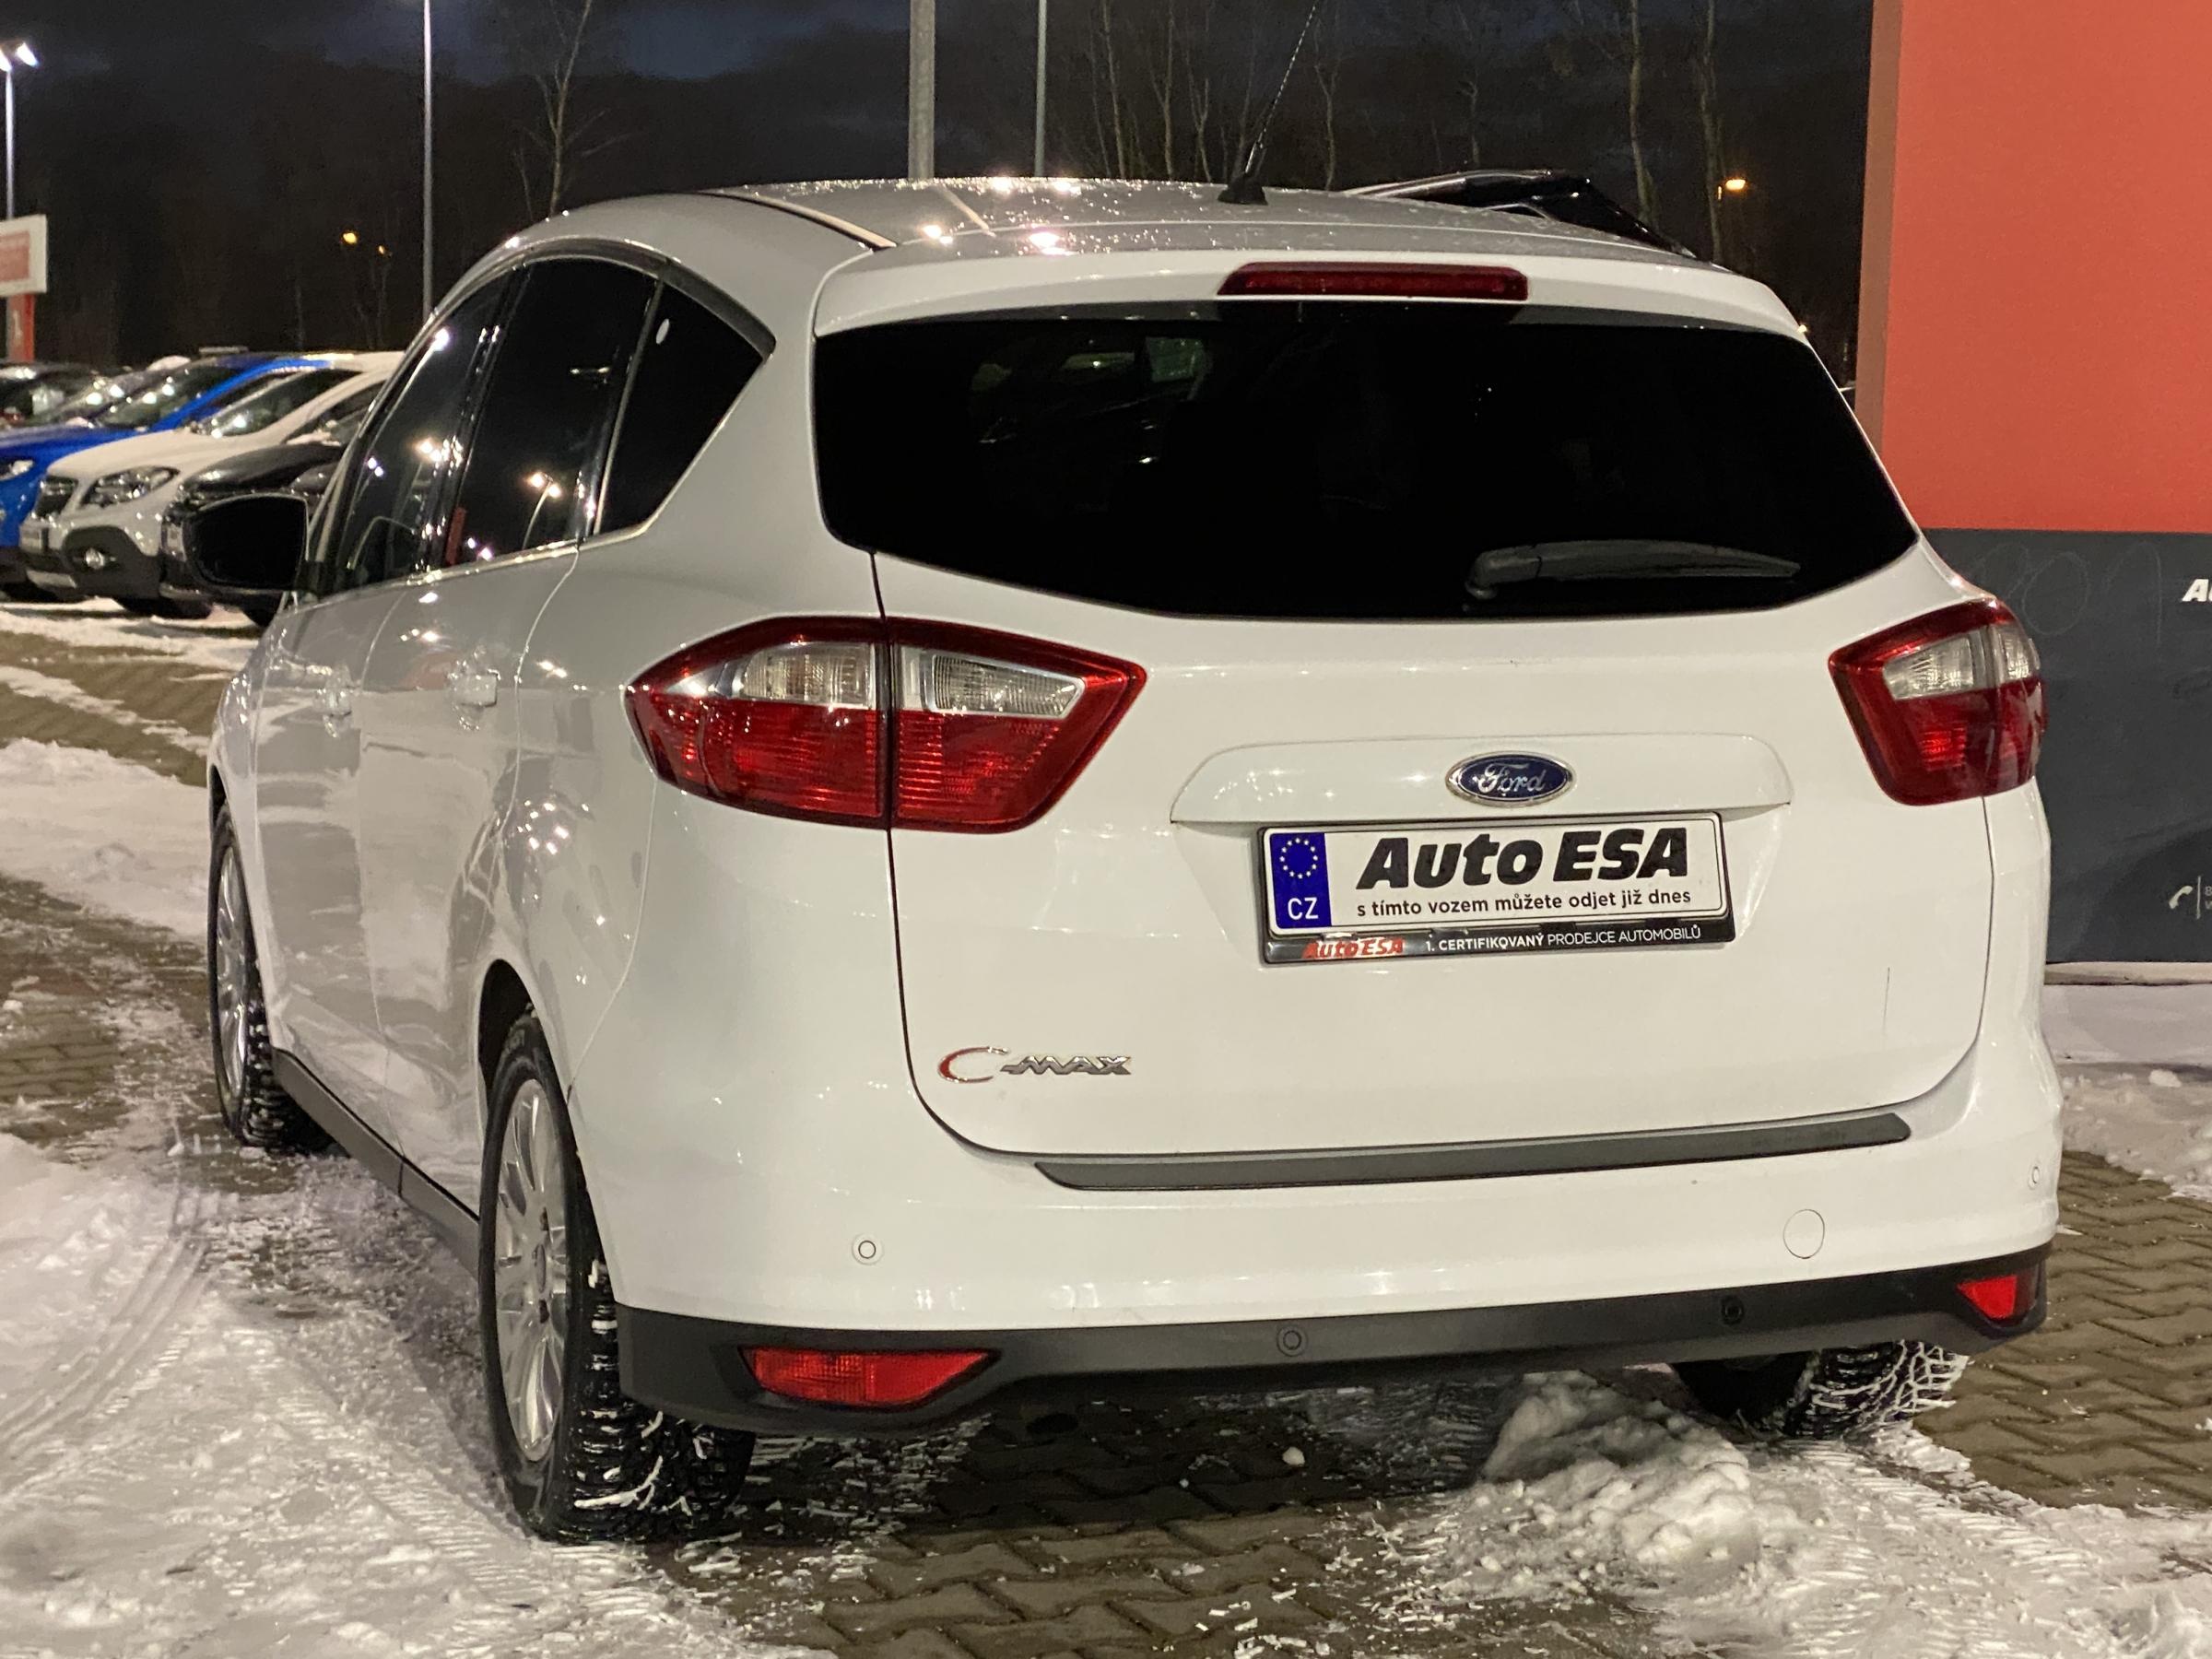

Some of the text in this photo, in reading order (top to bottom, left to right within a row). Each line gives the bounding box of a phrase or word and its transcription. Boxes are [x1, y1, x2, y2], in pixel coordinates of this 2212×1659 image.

[1472, 762, 1547, 796] Ford
[1553, 828, 1688, 881] ESA
[1288, 897, 1319, 920] CZ
[1358, 888, 1691, 917] s tímto vozem můžete odjet již dnes
[1426, 924, 1701, 952] 1. CERTIFIKOVANÝ PRODEJCE AUTOMOBILŮ
